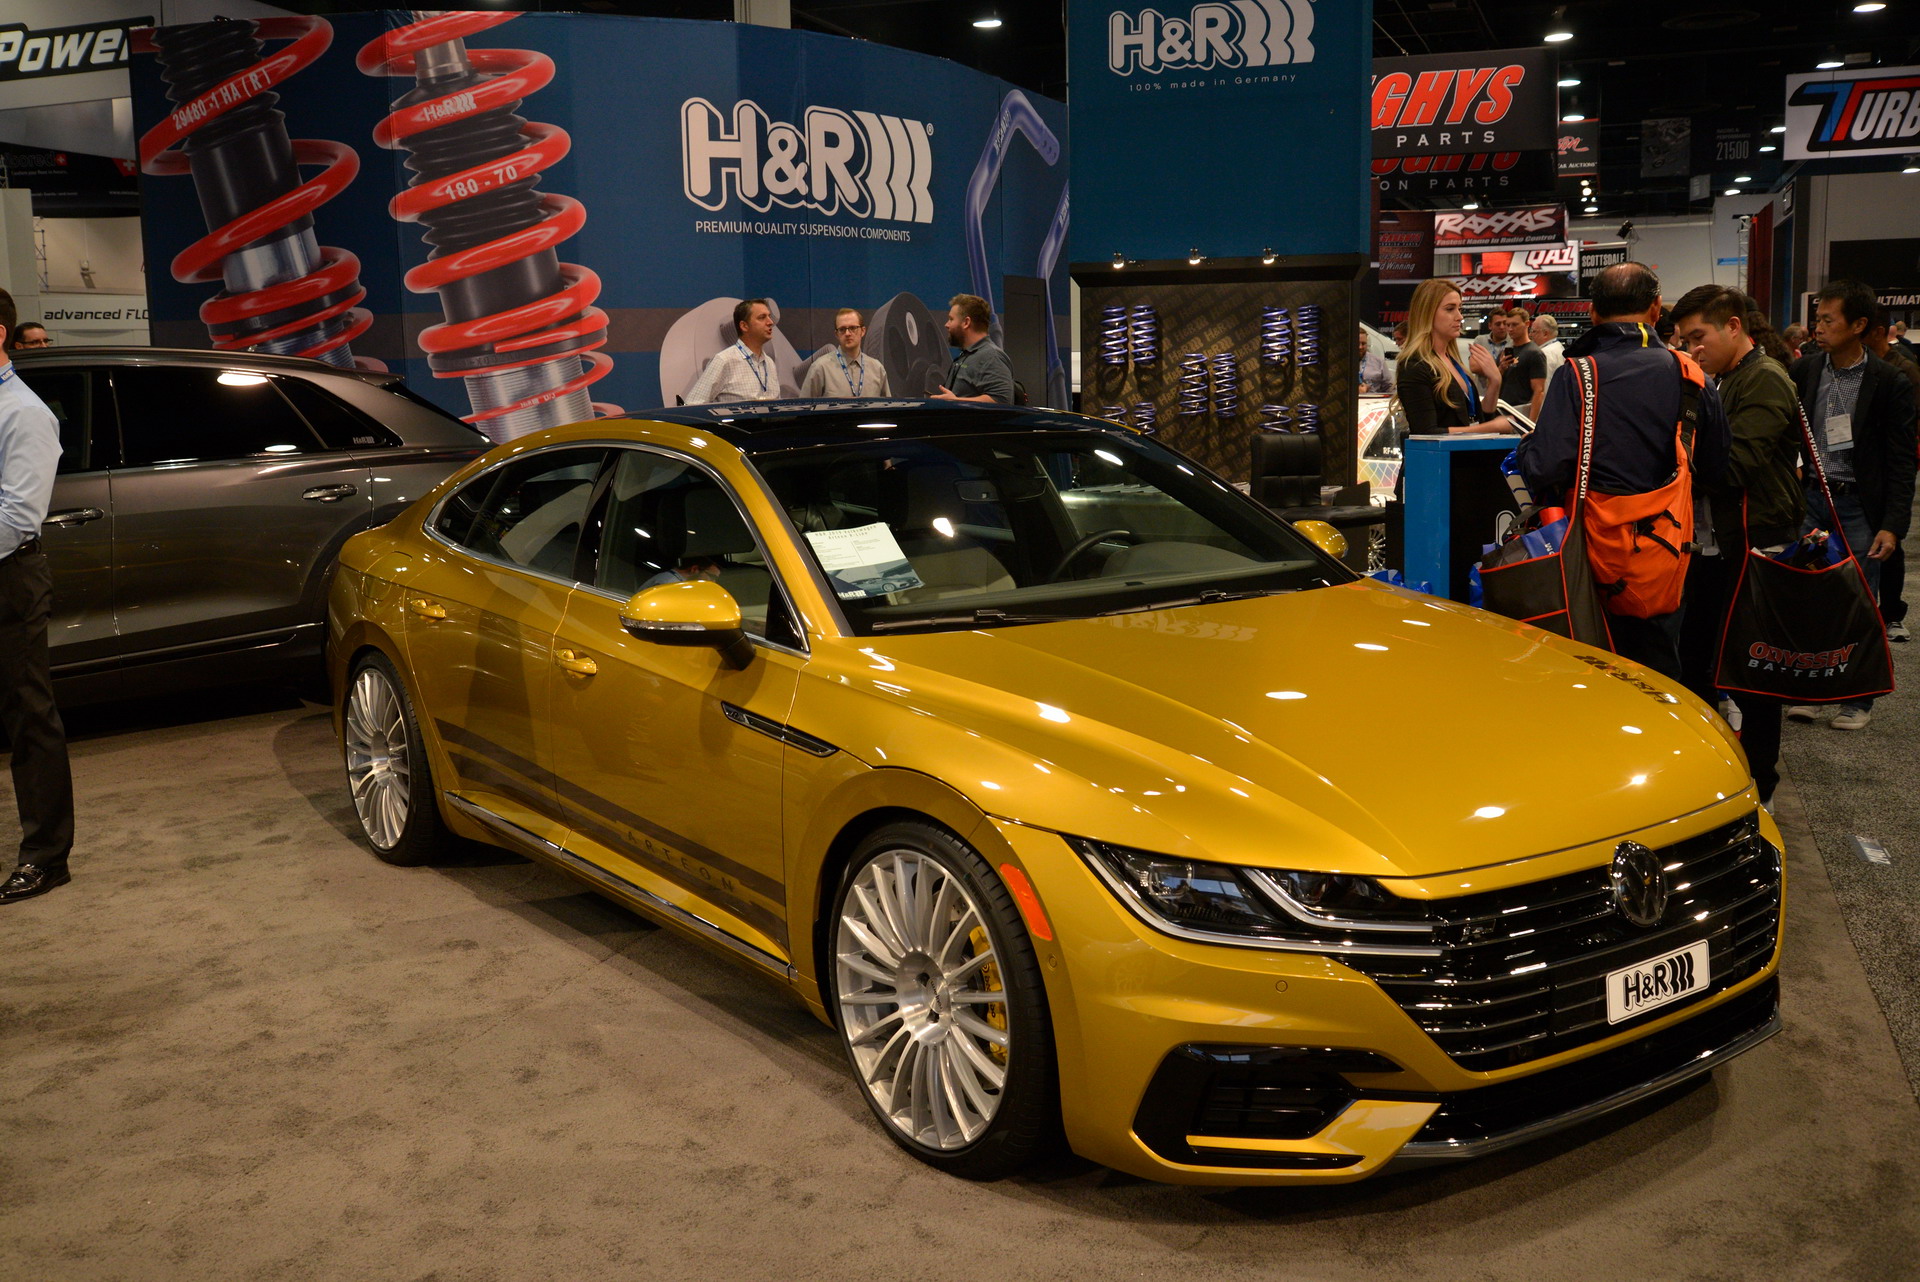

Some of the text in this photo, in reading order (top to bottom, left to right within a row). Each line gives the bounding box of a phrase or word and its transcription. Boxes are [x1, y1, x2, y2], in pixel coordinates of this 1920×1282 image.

[1109, 3, 1262, 76] H&R
[1130, 73, 1296, 92] 100% made in Germany
[1371, 64, 1525, 130] GHYS
[1396, 130, 1495, 147] PARTS
[681, 97, 890, 219] H&R
[1716, 140, 1749, 160] 21500
[445, 178, 479, 200] 180
[493, 165, 518, 184] 70
[1380, 176, 1510, 191] ON PARTS
[695, 220, 911, 242] PREMIUM QUALITY SUSPENSION COMPONENTS
[1437, 238, 1466, 246] Fastest
[1467, 237, 1490, 245] Name
[1525, 234, 1556, 242] Control
[1525, 246, 1573, 269] QA1
[1581, 252, 1626, 269] SCOTTSDALE
[44, 308, 121, 320] advanced
[1748, 641, 1856, 669] ODYSSEY
[628, 831, 734, 892] ARTEON
[1622, 959, 1684, 1012] H&R
